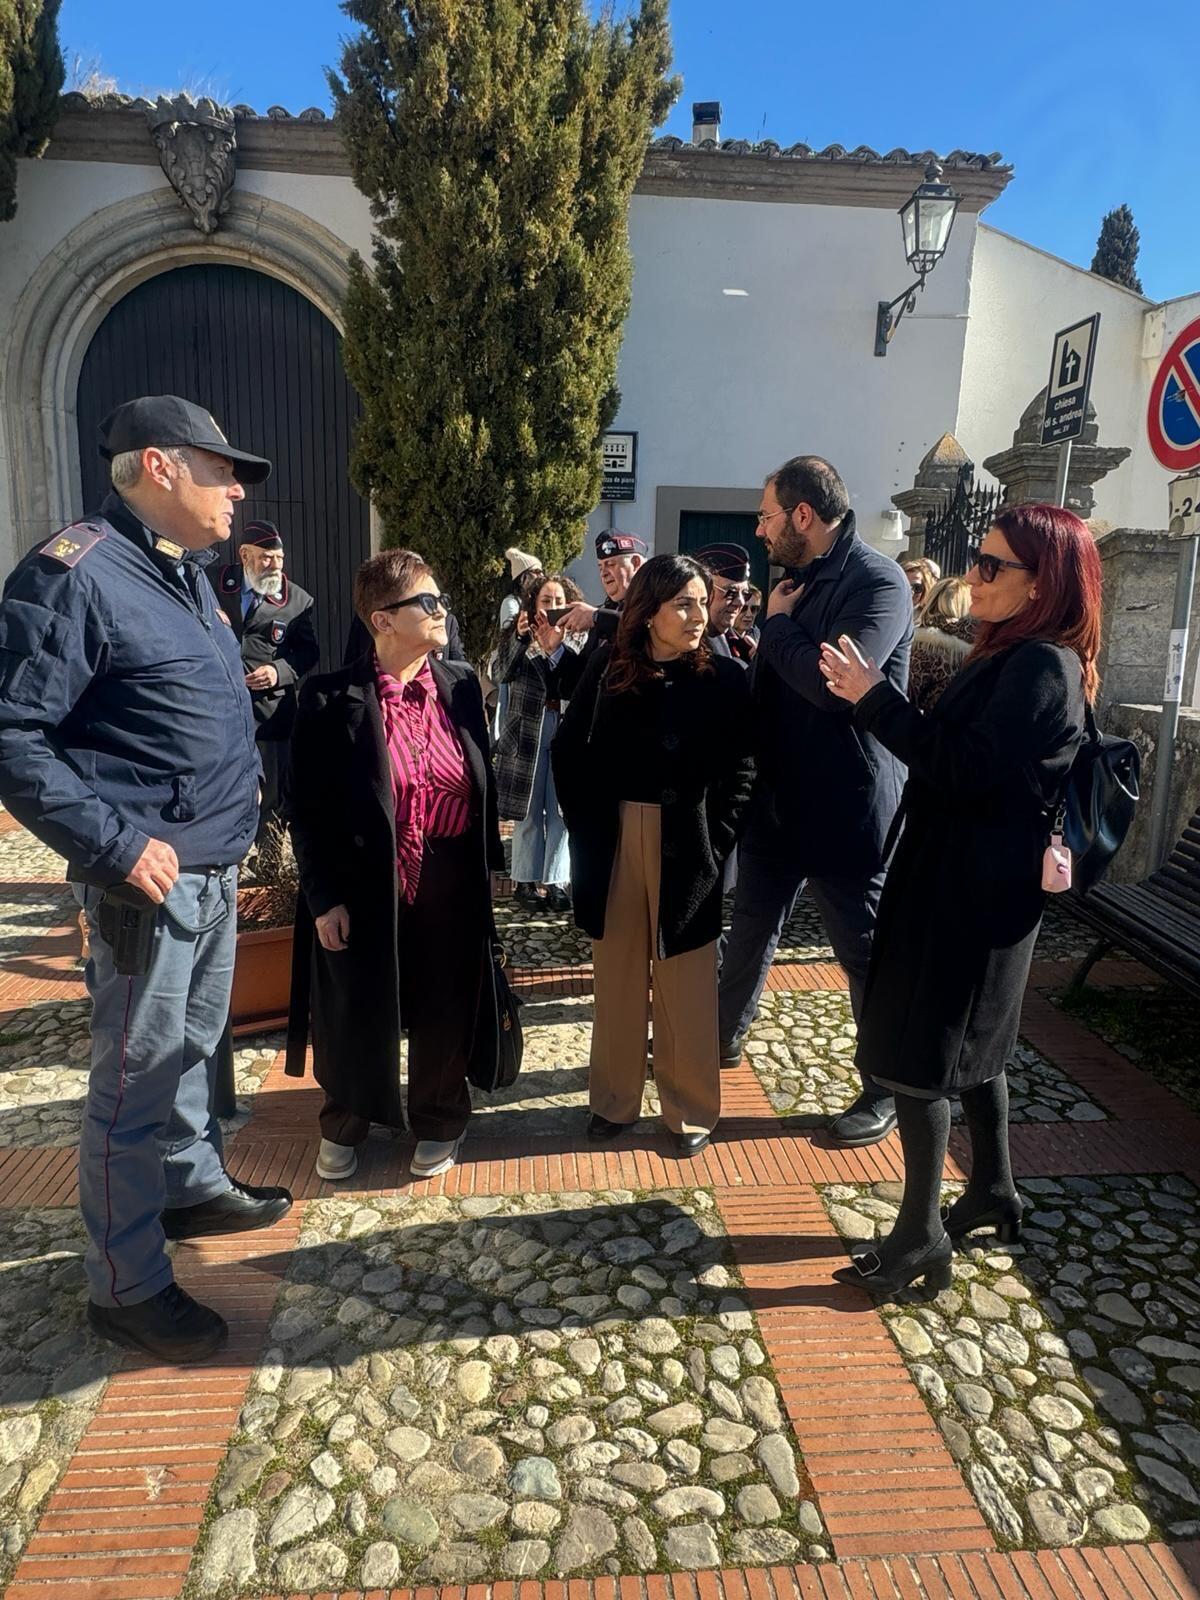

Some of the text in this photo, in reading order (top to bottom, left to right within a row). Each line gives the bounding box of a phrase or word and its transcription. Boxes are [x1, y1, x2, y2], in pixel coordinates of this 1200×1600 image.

[1054, 396, 1076, 411] chiesa
[1044, 417, 1052, 428] di
[1059, 409, 1083, 424] andrea
